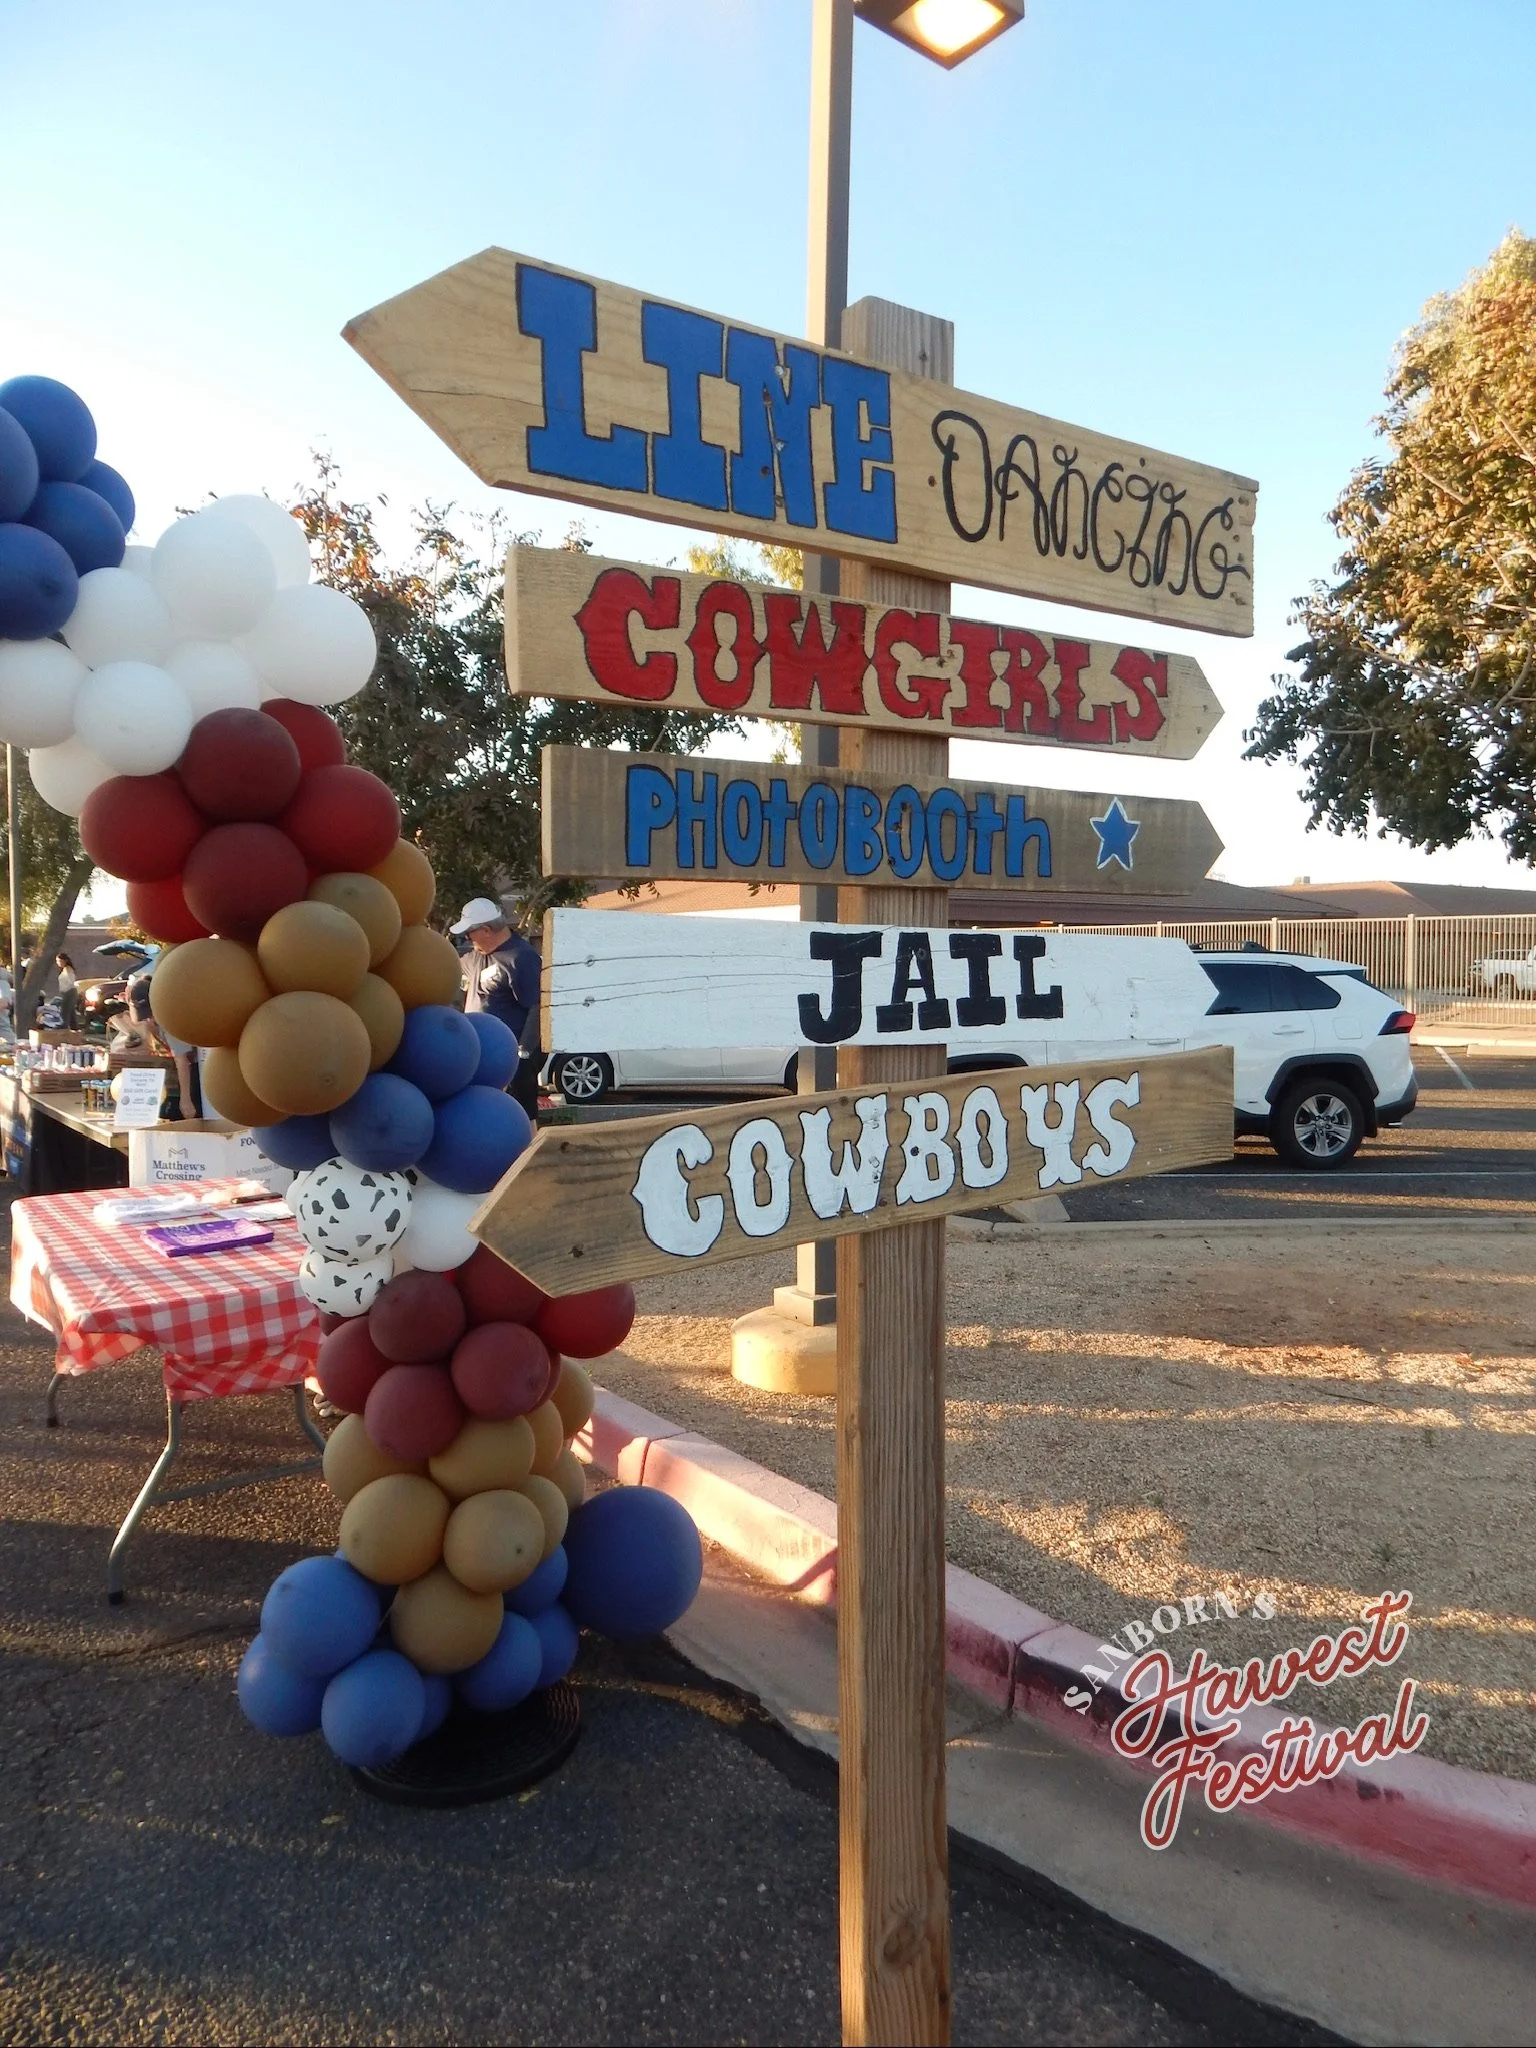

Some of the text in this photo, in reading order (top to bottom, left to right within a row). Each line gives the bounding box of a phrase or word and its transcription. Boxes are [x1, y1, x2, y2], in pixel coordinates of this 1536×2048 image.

[515, 262, 1250, 599] LINE DANCING
[575, 567, 1169, 745] COWGIRLS
[797, 930, 1064, 1044] JAIL
[153, 1160, 206, 1171] Matthew's
[156, 1171, 203, 1181] Crossing
[631, 1071, 1140, 1258] COWBOYS
